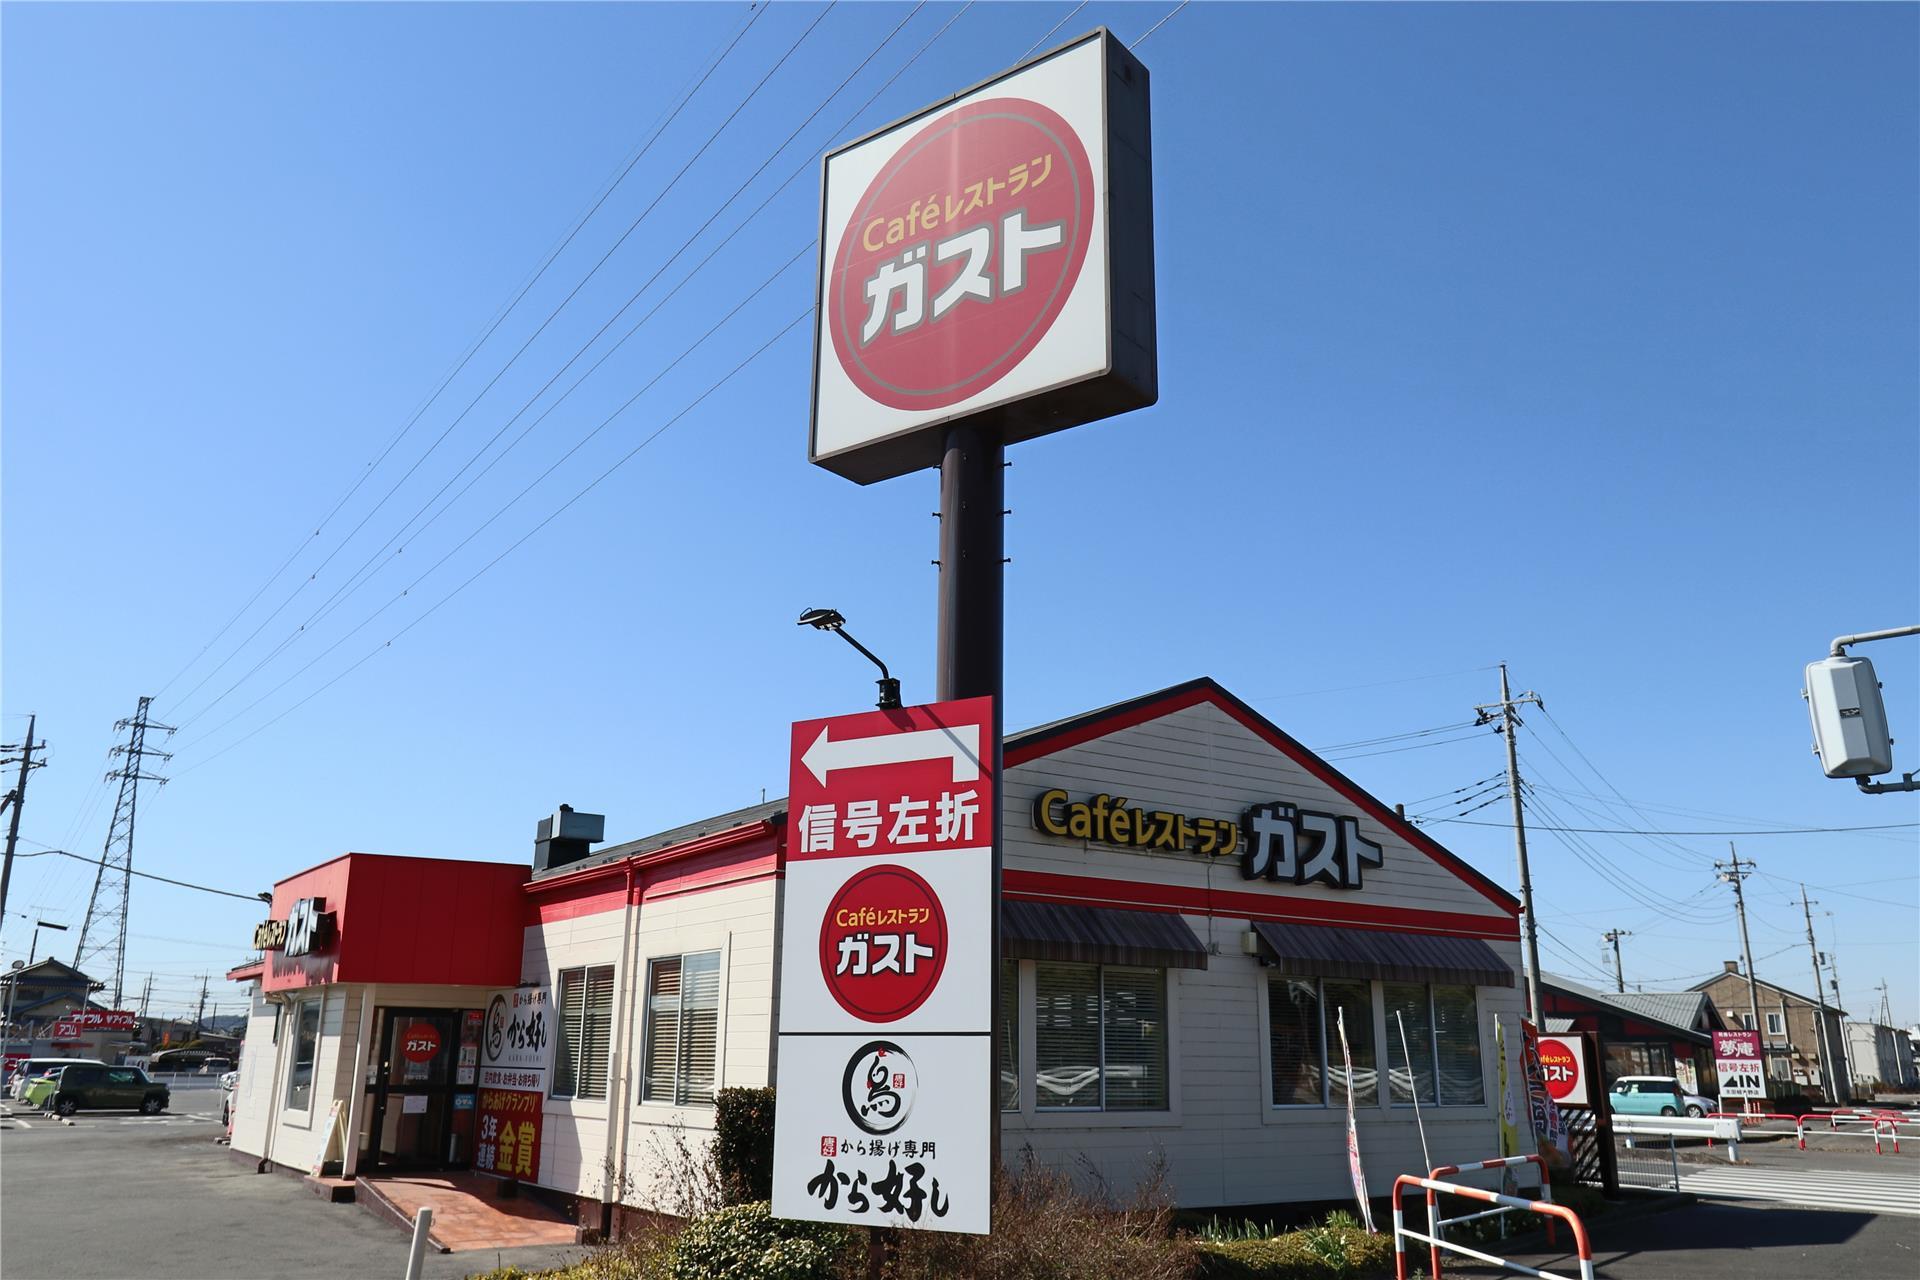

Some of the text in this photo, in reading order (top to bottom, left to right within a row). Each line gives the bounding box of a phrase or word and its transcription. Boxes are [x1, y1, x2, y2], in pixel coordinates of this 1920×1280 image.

[862, 153, 1053, 252] Caféレストラン
[860, 210, 1065, 346] ガスト
[798, 788, 980, 853] 信号左折
[1034, 788, 1383, 889] Caféレストラン ガスト
[284, 897, 319, 957] ガスト
[836, 907, 930, 927] Caféレストラン
[836, 932, 934, 976] ガスト
[58, 1023, 77, 1035] アコム
[72, 1014, 103, 1024] アイフル
[406, 1040, 437, 1051] ガスト
[1718, 1063, 1760, 1072] 信号左折
[1739, 1075, 1761, 1088] IN
[481, 1114, 498, 1142] 3年
[497, 1120, 536, 1177] 金賞
[840, 1138, 936, 1159] から揚げ専門
[807, 1158, 949, 1222] から好し
